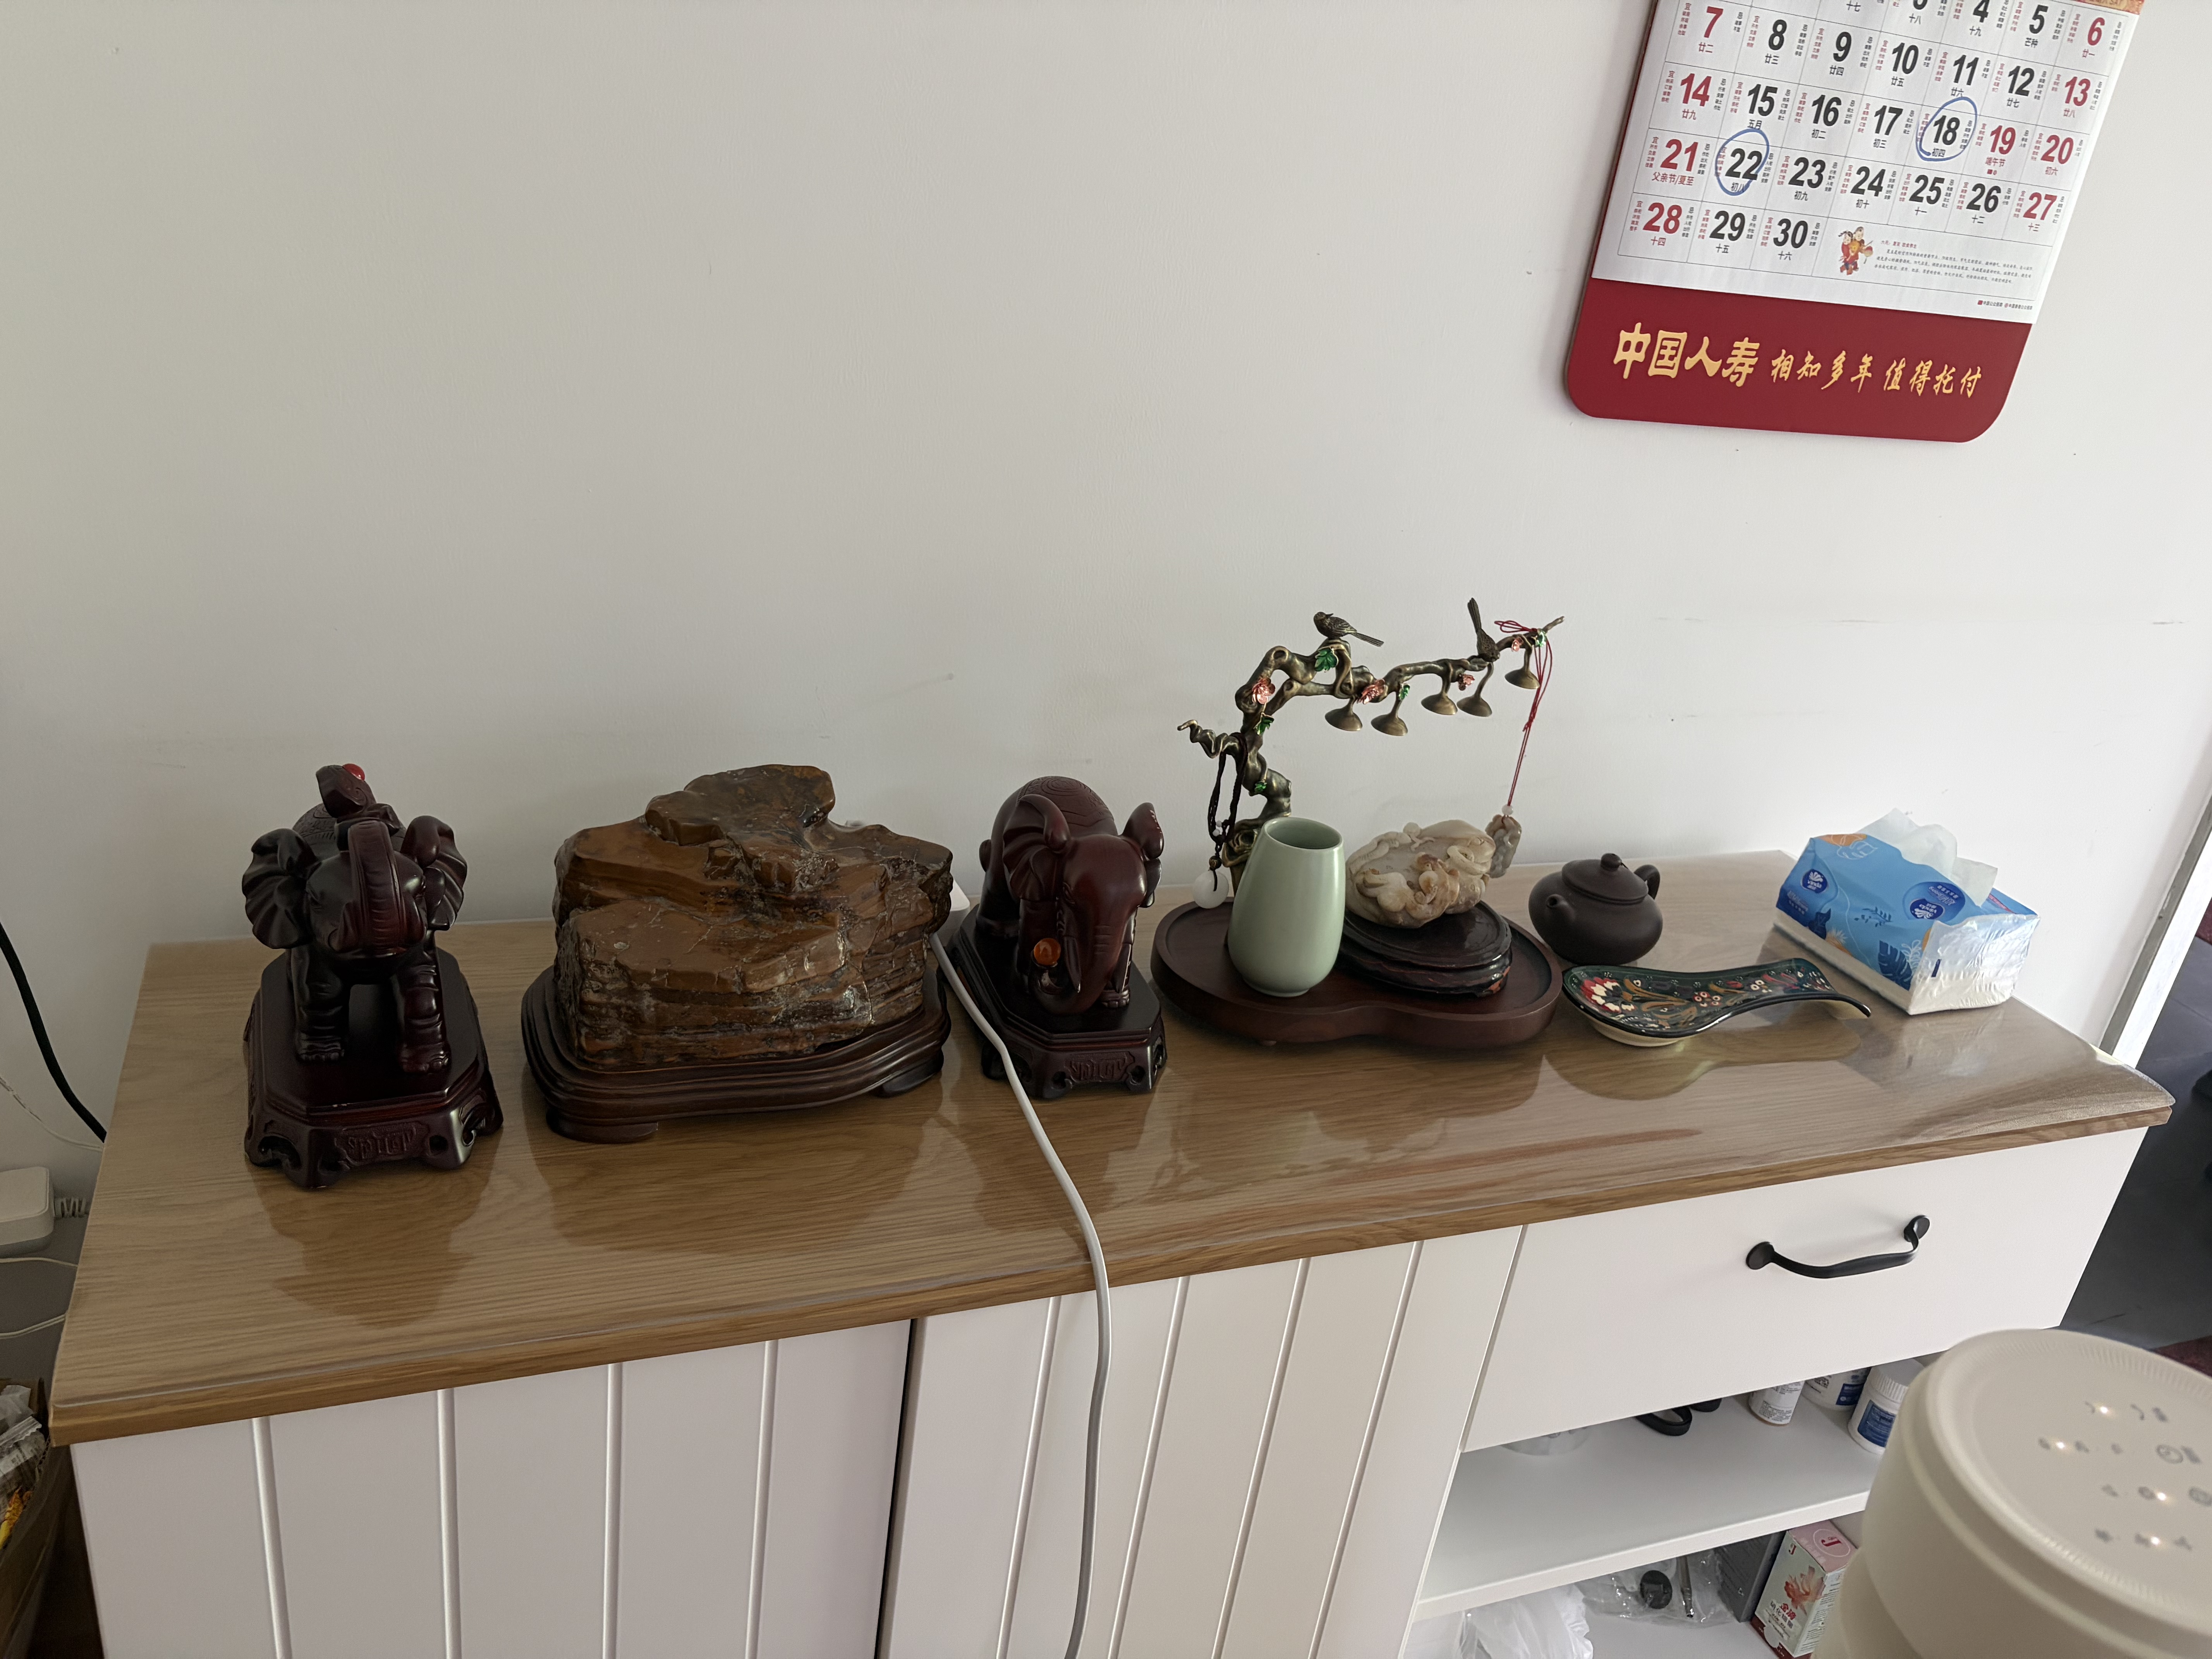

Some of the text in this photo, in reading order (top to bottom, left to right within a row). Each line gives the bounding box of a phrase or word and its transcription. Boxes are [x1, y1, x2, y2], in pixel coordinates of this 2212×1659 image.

[1846, 0, 1861, 12] 十七
[1973, 0, 1990, 23] 4
[1704, 6, 1724, 38] 7
[1908, 13, 1921, 25] 十八
[2029, 4, 2049, 34] 5
[1768, 19, 1787, 51] 8
[1969, 26, 1981, 37] 十九
[2087, 17, 2105, 46] 6
[1698, 41, 1714, 53] 廿二
[1833, 31, 1852, 62] 9
[2025, 37, 2039, 48] 芒种
[1765, 53, 1779, 65] 廿三
[1892, 42, 1919, 74] 10
[2082, 48, 2095, 58] 廿一
[1829, 65, 1844, 76] 廿四
[1953, 55, 1979, 86] 11
[1891, 76, 1905, 87] 廿五
[2008, 65, 2035, 97] 12
[1680, 73, 1712, 107] 14
[1951, 87, 1964, 97] 廿六
[2064, 76, 2091, 106] 13
[1747, 84, 1778, 117] 15
[2006, 98, 2020, 108] 廿七
[1682, 108, 1697, 120] 廿九
[1812, 94, 1842, 127] 16
[2063, 108, 2075, 118] 廿八
[1747, 119, 1762, 130] 五月
[1874, 105, 1903, 136] 17
[1811, 128, 1826, 139] 初二
[1933, 115, 1960, 146] 18
[1873, 138, 1887, 149] 初三
[1990, 125, 2016, 155] 19
[1660, 139, 1698, 172] 21
[1932, 148, 1946, 158] 初四
[2040, 134, 2074, 164] 20
[1725, 148, 1763, 180] 22
[1985, 157, 2006, 167] 端午节
[1788, 157, 1826, 189] 23
[2045, 166, 2059, 176] 初六
[1651, 172, 1695, 186] 父亲节/夏至
[1850, 166, 1886, 197] 24
[1794, 191, 1808, 201] 初九
[1909, 174, 1945, 204] 25
[1856, 199, 1870, 209] 初十
[1966, 183, 2001, 213] 26
[1914, 206, 1927, 216] 十一
[2023, 192, 2057, 220] 27
[1642, 202, 1682, 234] 28
[1972, 215, 1985, 224] 十二
[1709, 210, 1745, 241] 29
[2028, 223, 2040, 232] 十三
[1773, 218, 1808, 249] 30
[1650, 236, 1666, 246] 十四
[1716, 243, 1730, 254] 十五
[1778, 251, 1793, 261] 十六
[1613, 322, 1982, 398] 中国人寿 相知多年 值得托付
[1808, 879, 1822, 888] vinda
